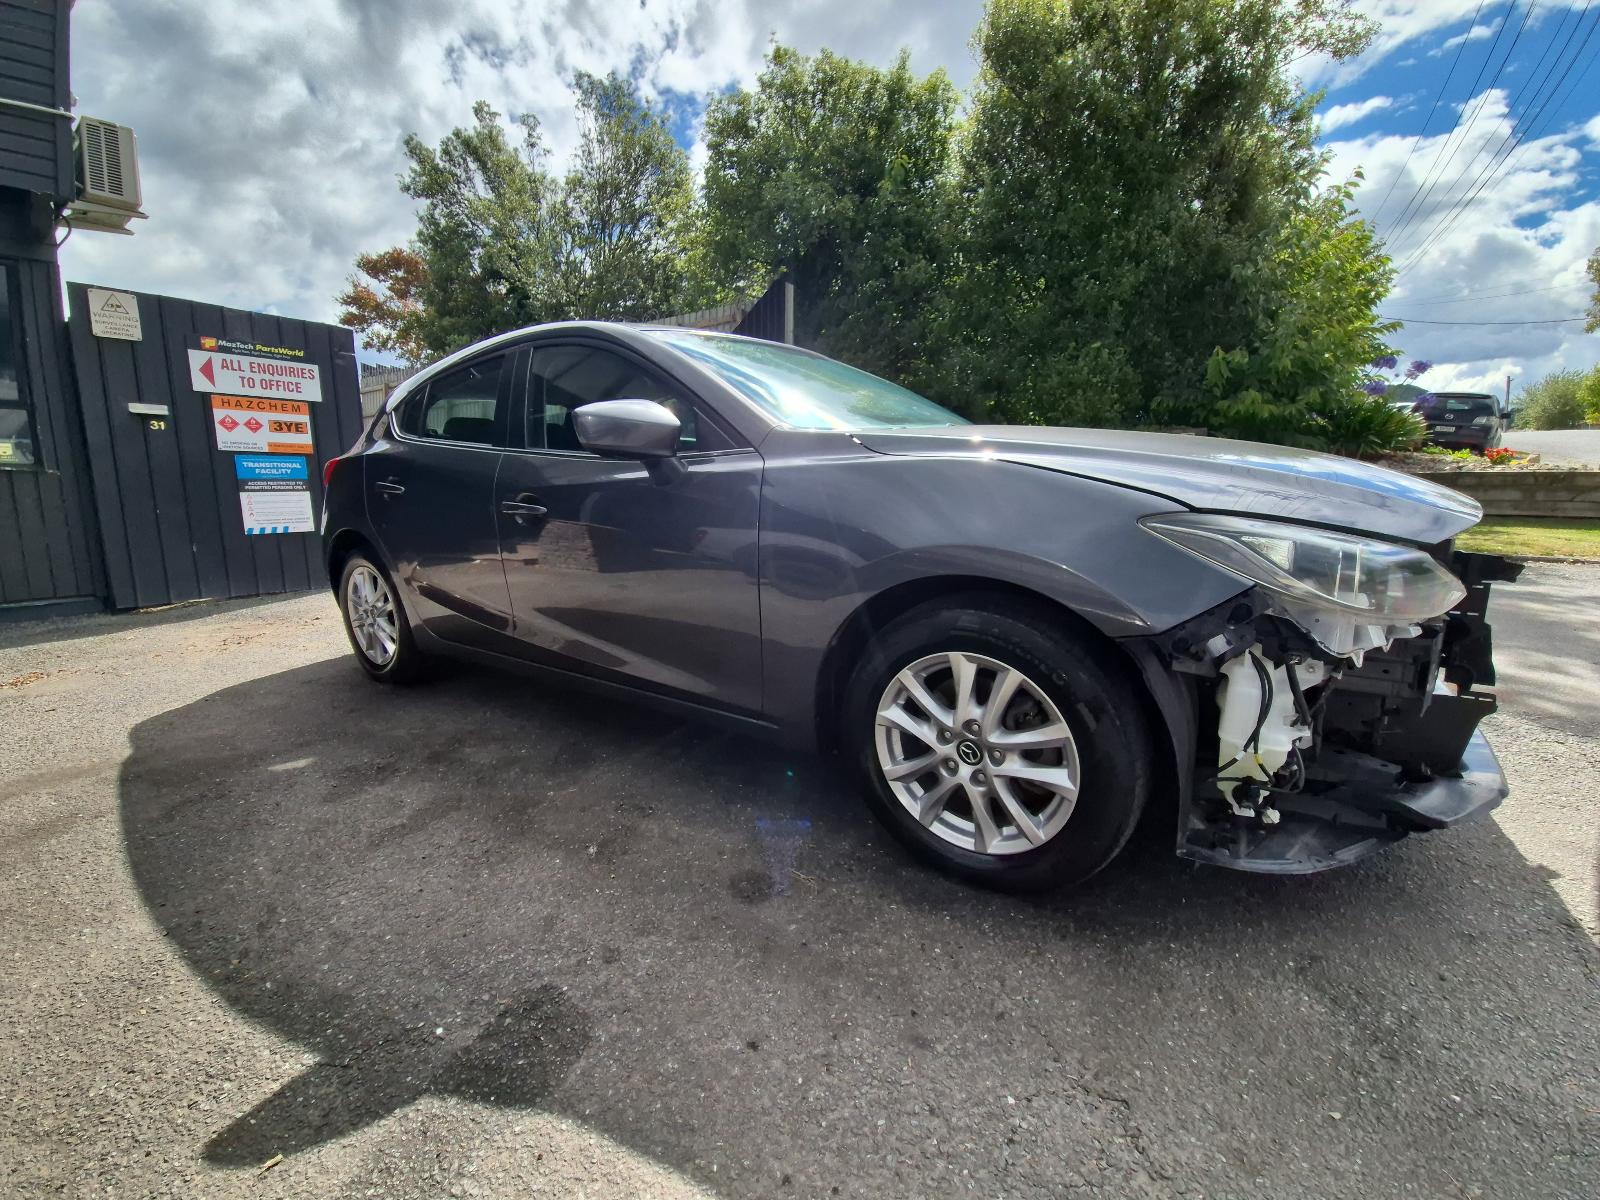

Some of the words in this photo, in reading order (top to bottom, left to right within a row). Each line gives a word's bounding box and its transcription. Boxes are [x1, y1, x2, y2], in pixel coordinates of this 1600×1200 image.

[217, 339, 254, 350] MazTech
[255, 344, 304, 357] PartsWorld
[220, 358, 245, 373] ALL
[249, 361, 316, 380] ENQUIRIES
[239, 375, 256, 389] TO
[260, 379, 303, 394] OFFICE
[221, 398, 301, 413] HAZCHEM
[150, 420, 165, 431] 31
[273, 421, 304, 433] 3YE
[242, 461, 302, 469] TRANSITIONAL
